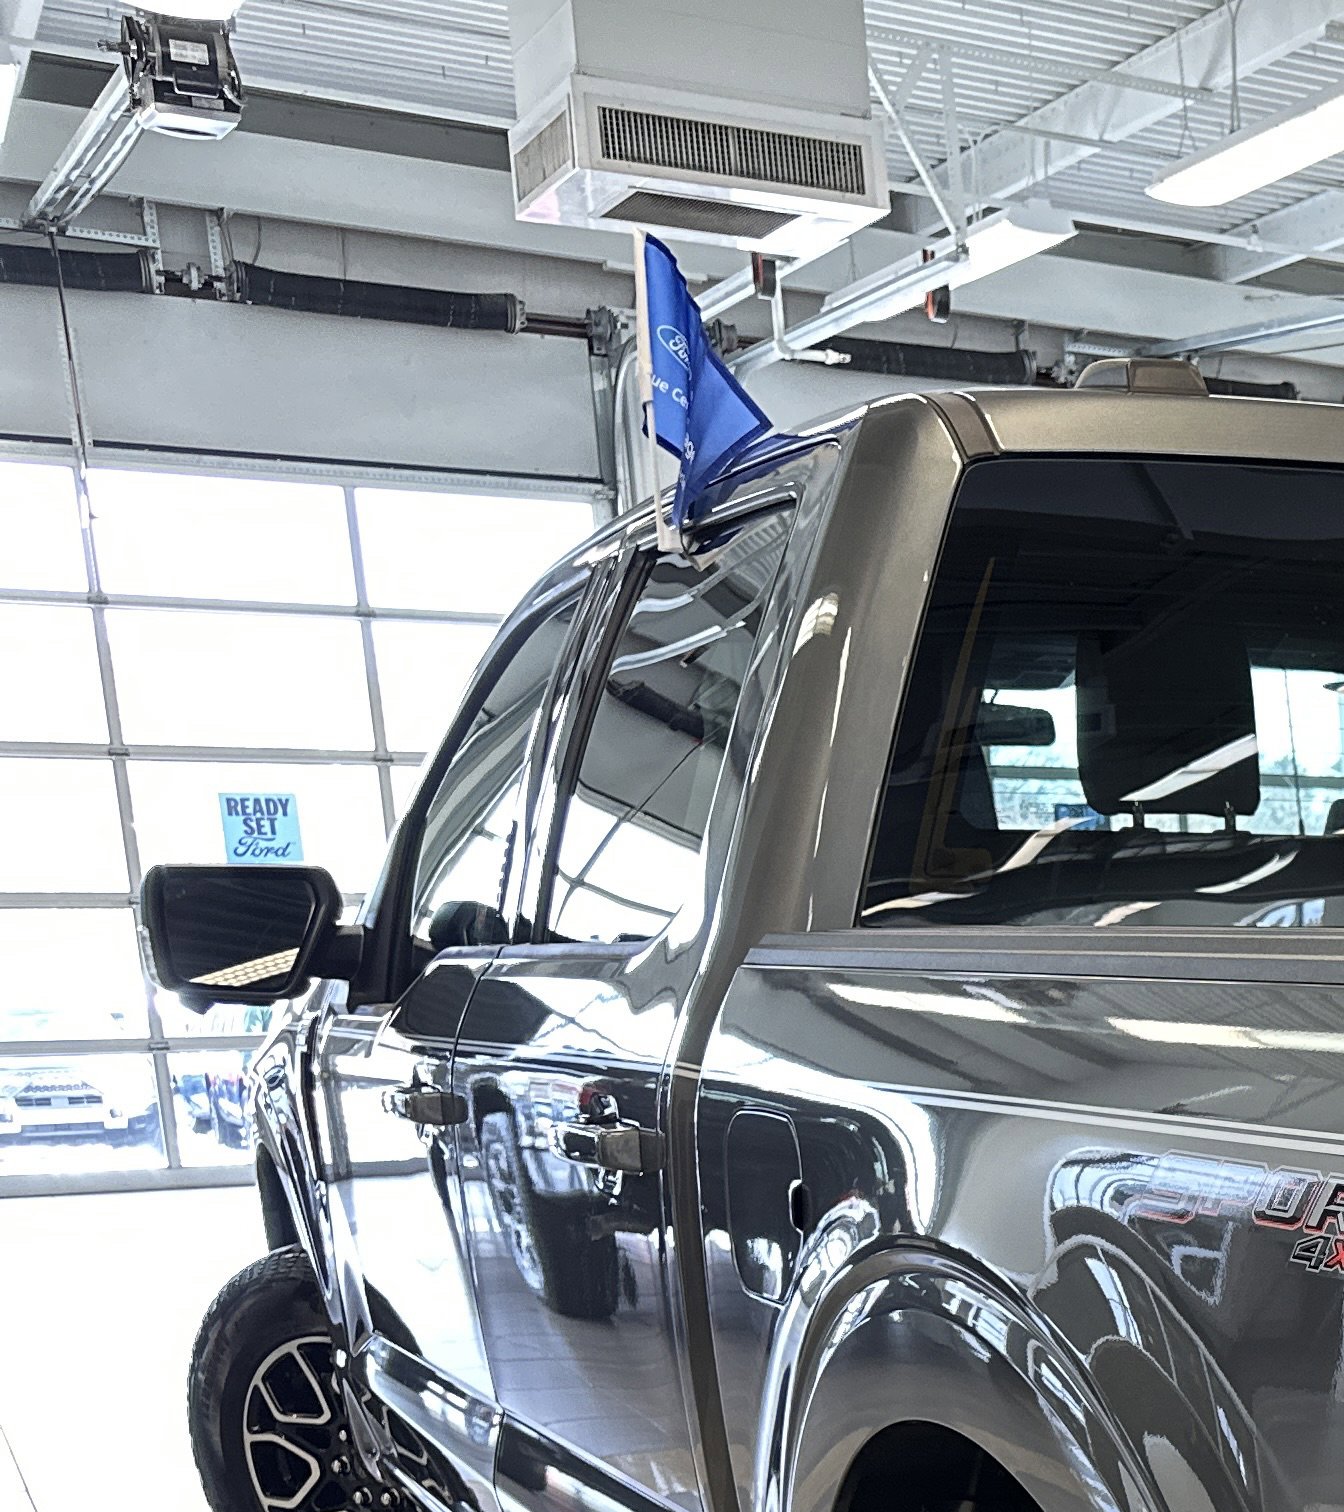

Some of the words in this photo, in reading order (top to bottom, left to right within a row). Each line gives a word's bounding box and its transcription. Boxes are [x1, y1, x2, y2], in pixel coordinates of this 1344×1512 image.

[226, 797, 290, 817] READY
[242, 817, 278, 837] SET
[233, 835, 294, 859] Ford
